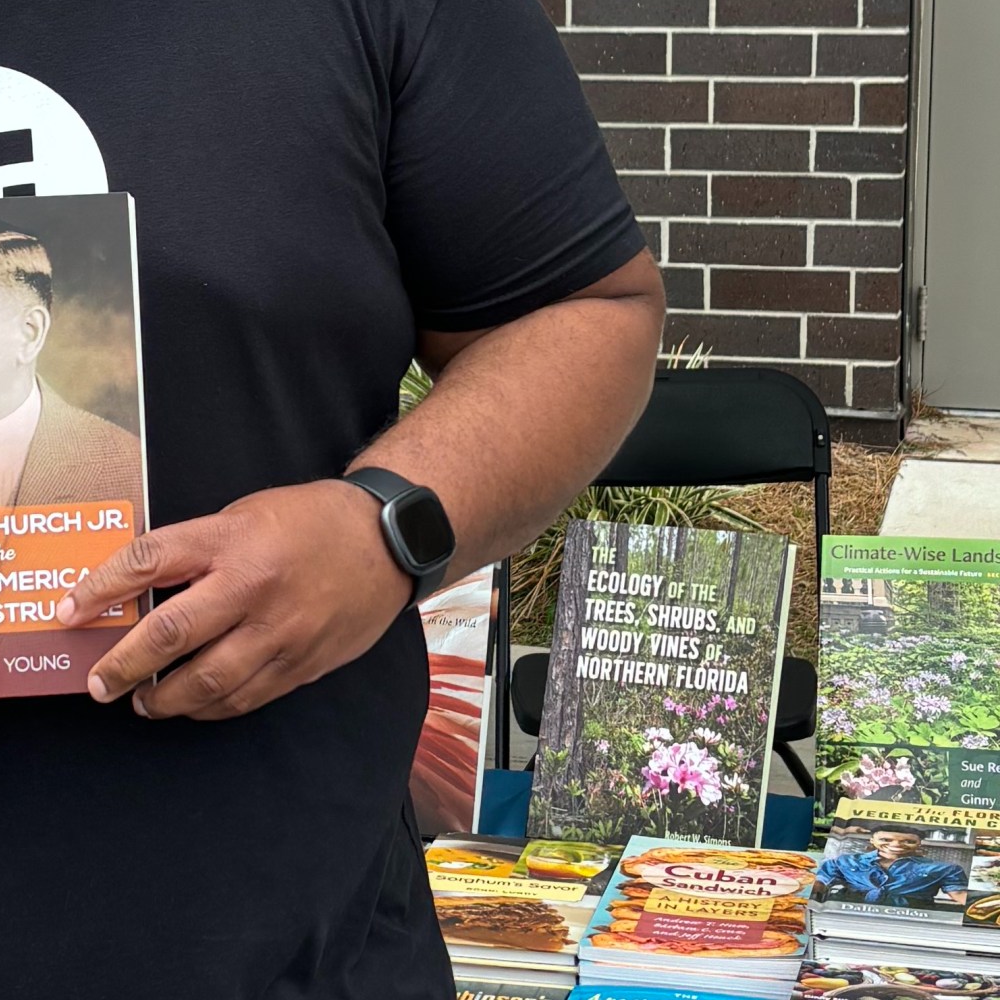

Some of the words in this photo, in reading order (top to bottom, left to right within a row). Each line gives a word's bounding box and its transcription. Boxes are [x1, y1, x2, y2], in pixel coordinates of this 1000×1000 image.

[87, 509, 129, 531] JR.
[591, 546, 617, 565] THE
[831, 545, 946, 562] Climate-Wise
[901, 567, 912, 575] for
[587, 570, 664, 598] ECOLOGY
[668, 581, 685, 599] OF
[690, 583, 717, 601] THE
[439, 617, 453, 626] the
[455, 618, 477, 628] Wild
[584, 598, 640, 627] TREES,
[725, 617, 756, 635] AND
[581, 627, 643, 654] WOODY
[650, 633, 700, 660] VINES
[705, 643, 724, 661] OF
[3, 653, 71, 673] YOUNG
[576, 655, 669, 686] NORTHERN
[675, 665, 749, 694] FLORIDA
[961, 760, 984, 772] Sue
[961, 777, 982, 789] and
[961, 794, 996, 809] Ginny
[853, 809, 977, 827] VEGETARIAN
[952, 810, 1000, 820] FLOR
[665, 830, 691, 842] Robert
[703, 835, 732, 847] Simons
[435, 874, 524, 888] Sorghum's
[528, 882, 579, 893] Savor
[665, 865, 777, 886] Cuban
[662, 878, 772, 897] Sandwich
[657, 902, 677, 910] IN
[686, 904, 758, 918] LAYERS
[659, 895, 671, 903] A
[678, 897, 763, 910] HISTORY
[841, 903, 880, 913] Dalia
[654, 917, 702, 925] Andrew
